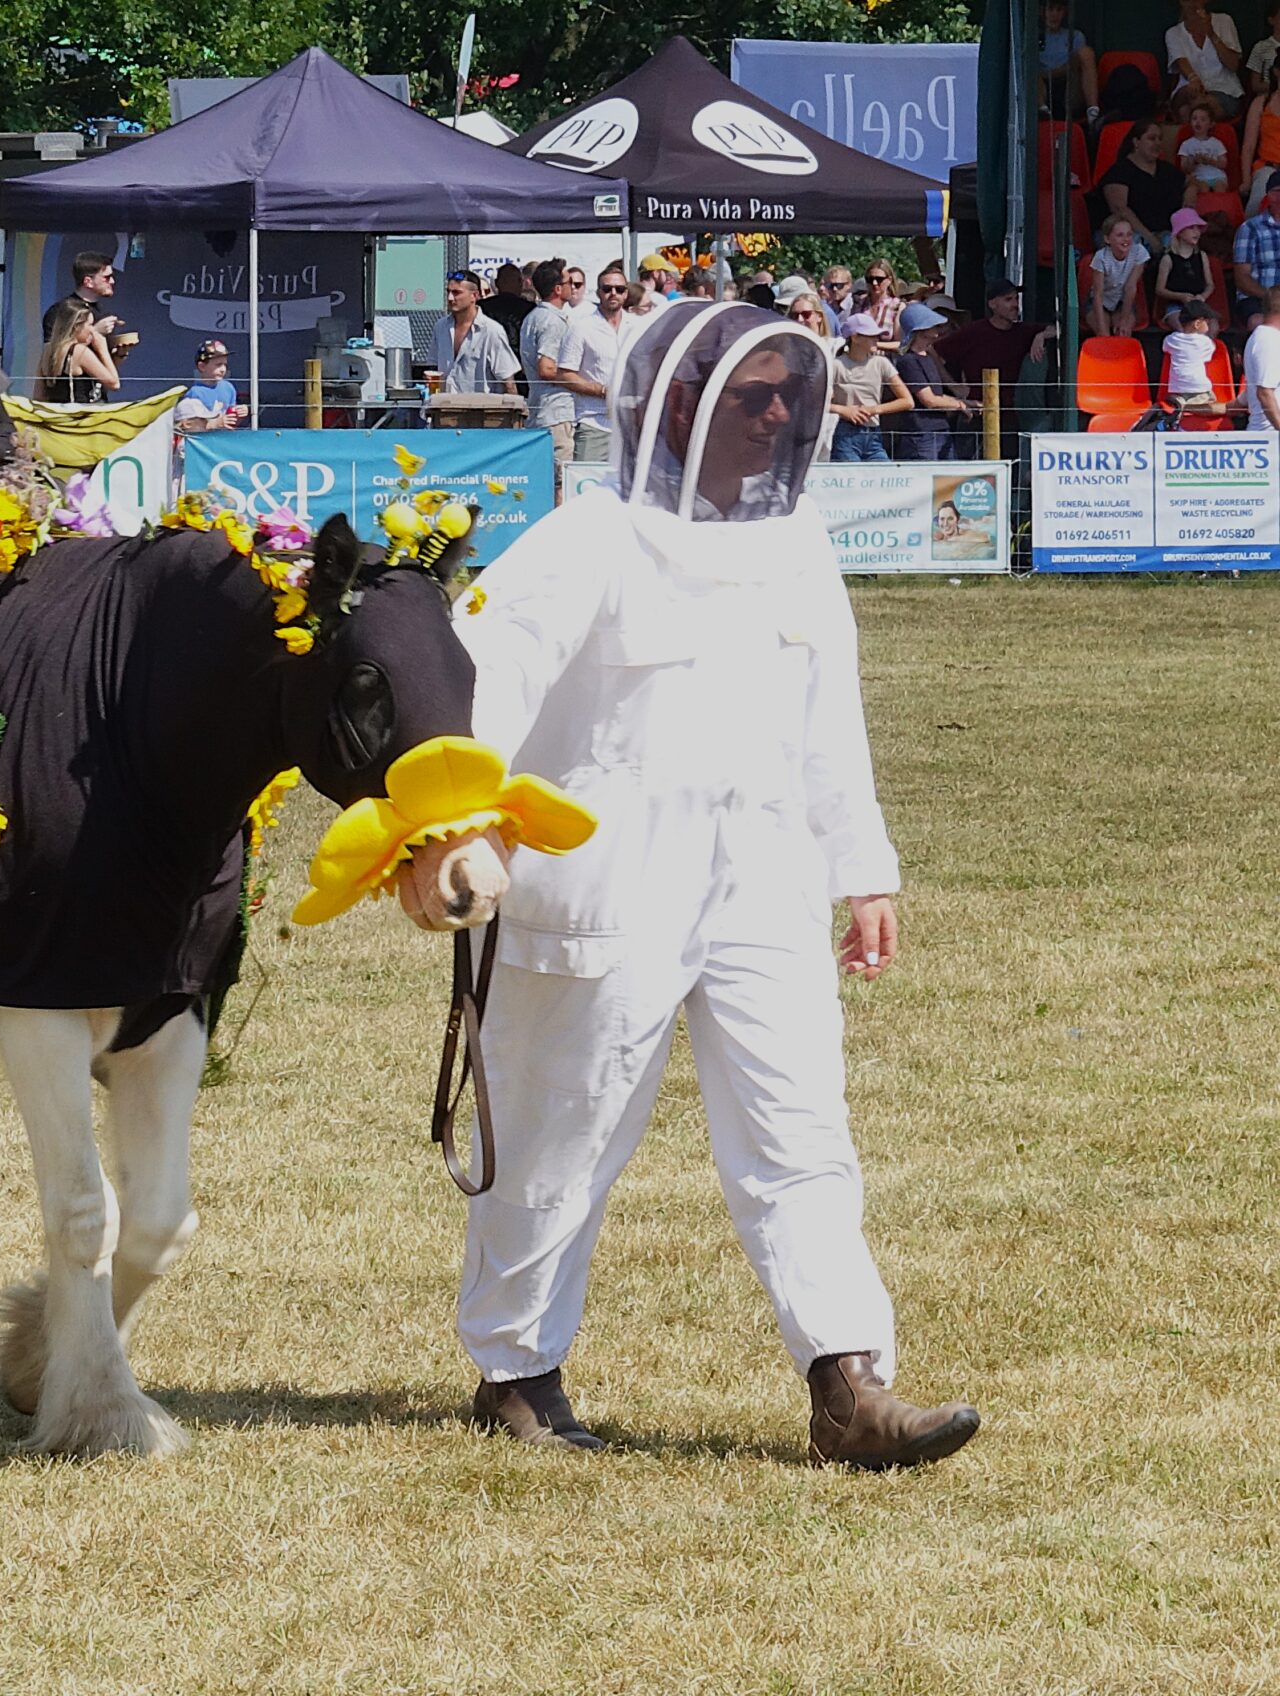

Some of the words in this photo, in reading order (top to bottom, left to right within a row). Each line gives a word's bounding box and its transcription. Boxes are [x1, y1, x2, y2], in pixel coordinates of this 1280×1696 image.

[705, 122, 786, 151] PVP
[647, 196, 692, 219] Pura
[698, 198, 741, 219] Vida
[750, 199, 796, 220] Pans
[1038, 450, 1148, 471] DRURY'S
[1165, 448, 1269, 470] DRURY'S
[431, 474, 477, 485] Financial
[1058, 474, 1130, 485] TRANSPORT
[1165, 472, 1230, 480] ENVIRONMENTAL
[1233, 471, 1269, 479] SERVICES
[821, 477, 856, 488] SALE
[860, 479, 874, 488] or
[880, 476, 913, 488] HIRE
[208, 460, 335, 520] S&P
[961, 481, 988, 496] 0%
[1056, 500, 1092, 508] GENERAL
[1094, 500, 1131, 508] HAULAGE
[1170, 499, 1188, 507] SKIP
[1190, 499, 1208, 507] HIRE
[1215, 498, 1265, 506] AGGREGATES
[818, 507, 916, 520] AINTENANCE
[1044, 511, 1079, 519] STORAGE
[1086, 510, 1143, 519] WAREHOUSING
[1181, 510, 1209, 518] WASTE
[1211, 509, 1254, 517] RECYCLING
[829, 530, 899, 548] 4005
[1055, 530, 1089, 541] 01692
[1091, 530, 1132, 541] 406511
[1178, 529, 1213, 540] 01692
[1215, 528, 1256, 539] 405820
